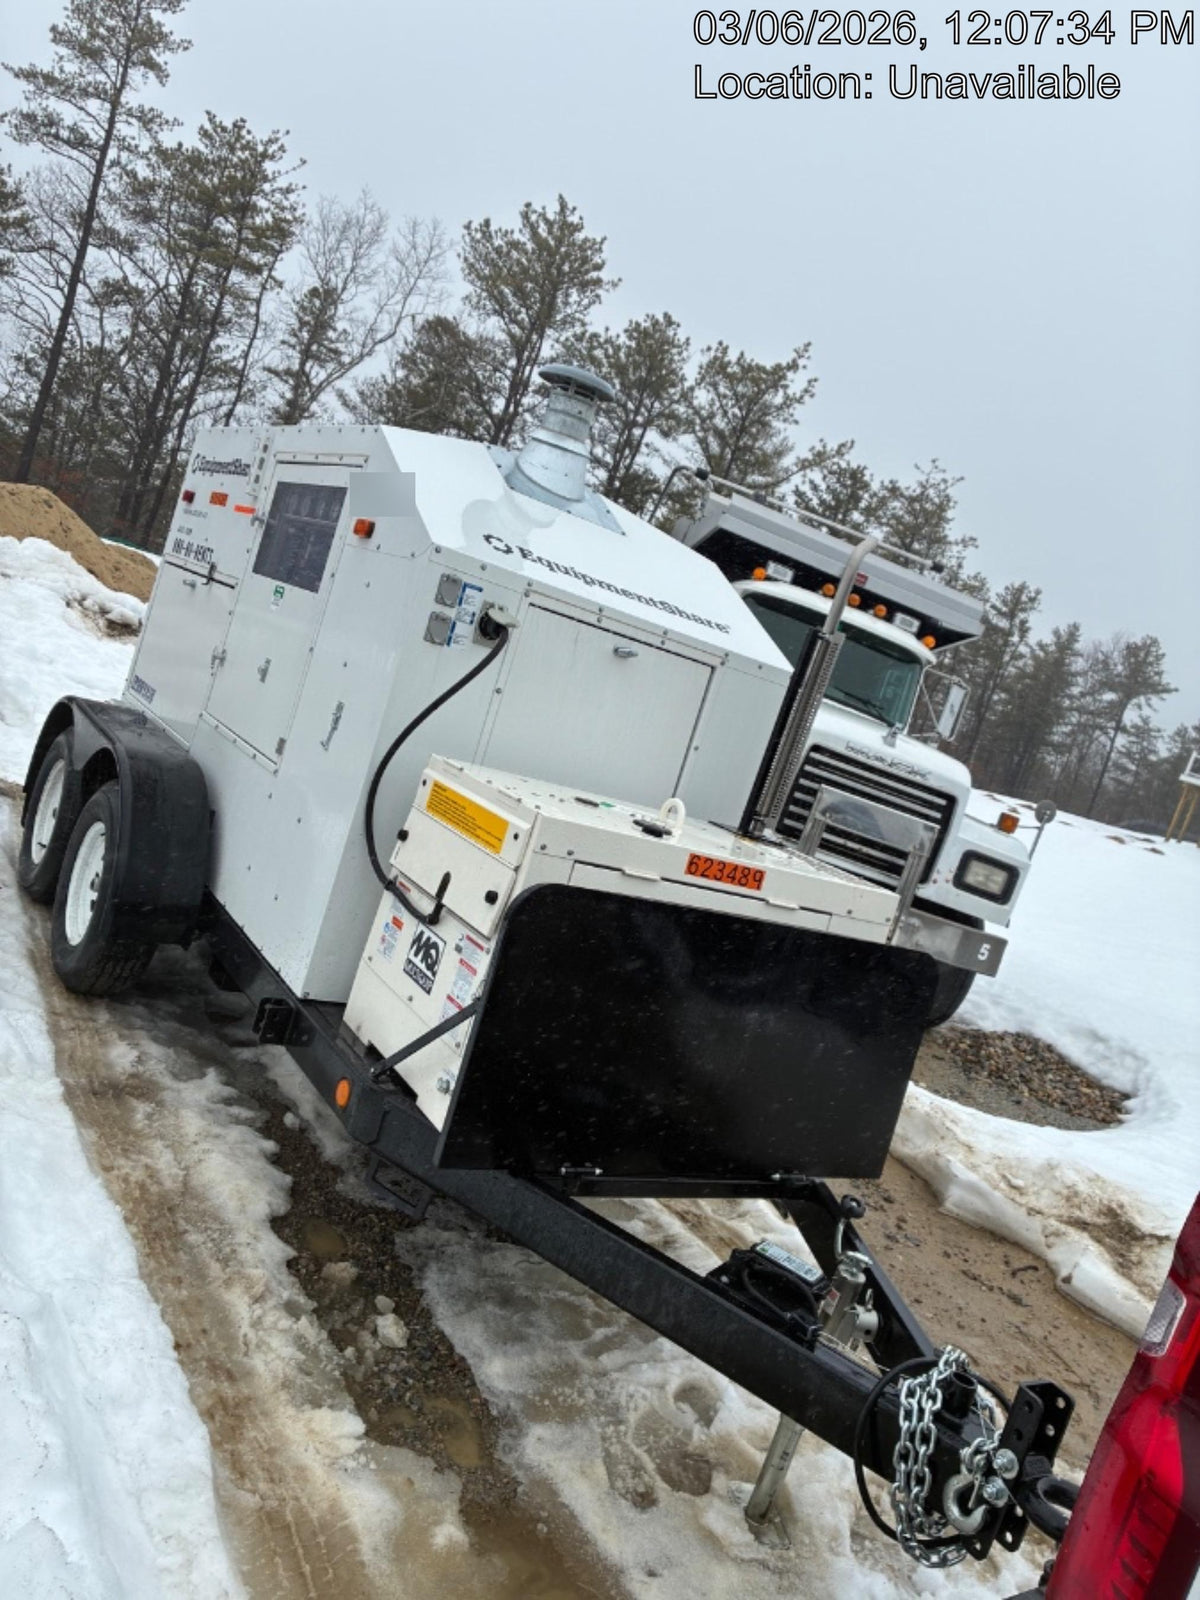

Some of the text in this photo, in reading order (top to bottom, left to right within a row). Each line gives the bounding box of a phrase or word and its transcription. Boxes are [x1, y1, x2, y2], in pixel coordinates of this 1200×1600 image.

[515, 544, 732, 634] EquipmentShare
[686, 854, 764, 891] 623489
[977, 943, 991, 961] 5
